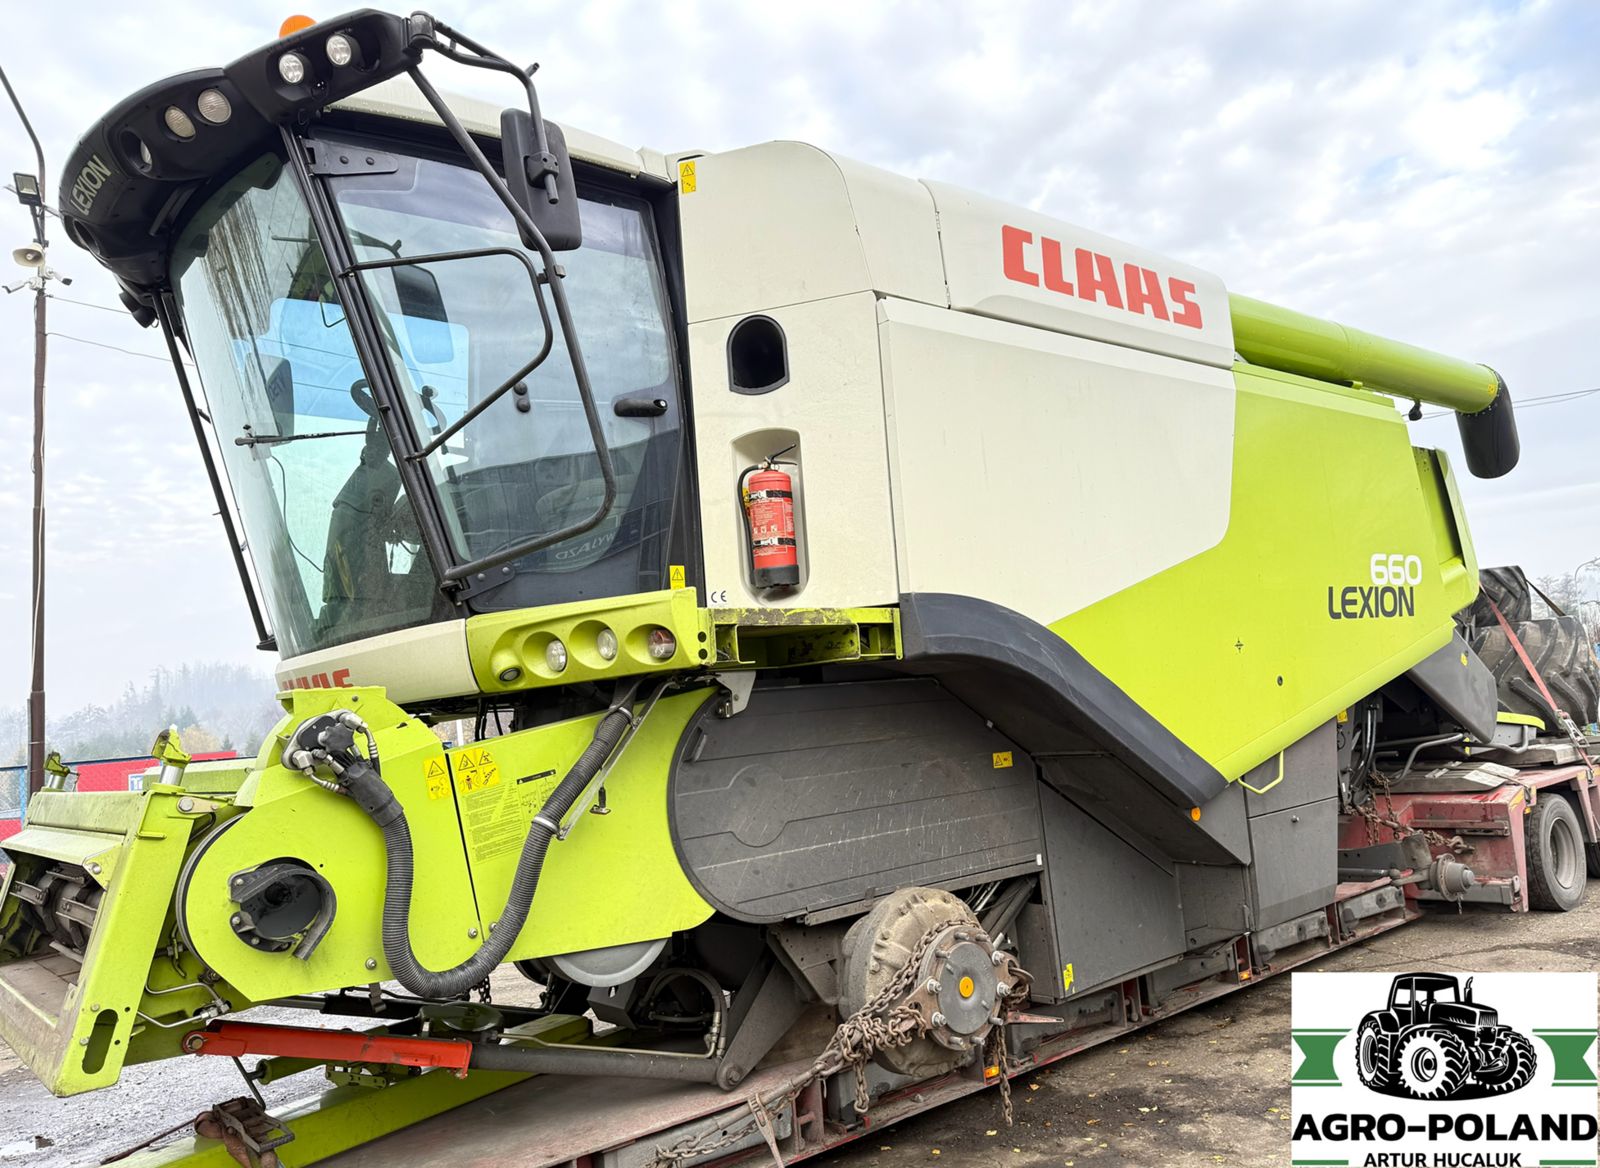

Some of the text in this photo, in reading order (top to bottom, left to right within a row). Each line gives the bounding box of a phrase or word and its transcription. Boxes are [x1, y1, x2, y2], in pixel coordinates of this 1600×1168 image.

[71, 154, 112, 216] LEXION
[1002, 224, 1203, 329] CLAAS
[1370, 553, 1422, 586] 660
[1328, 586, 1415, 619] LEXION
